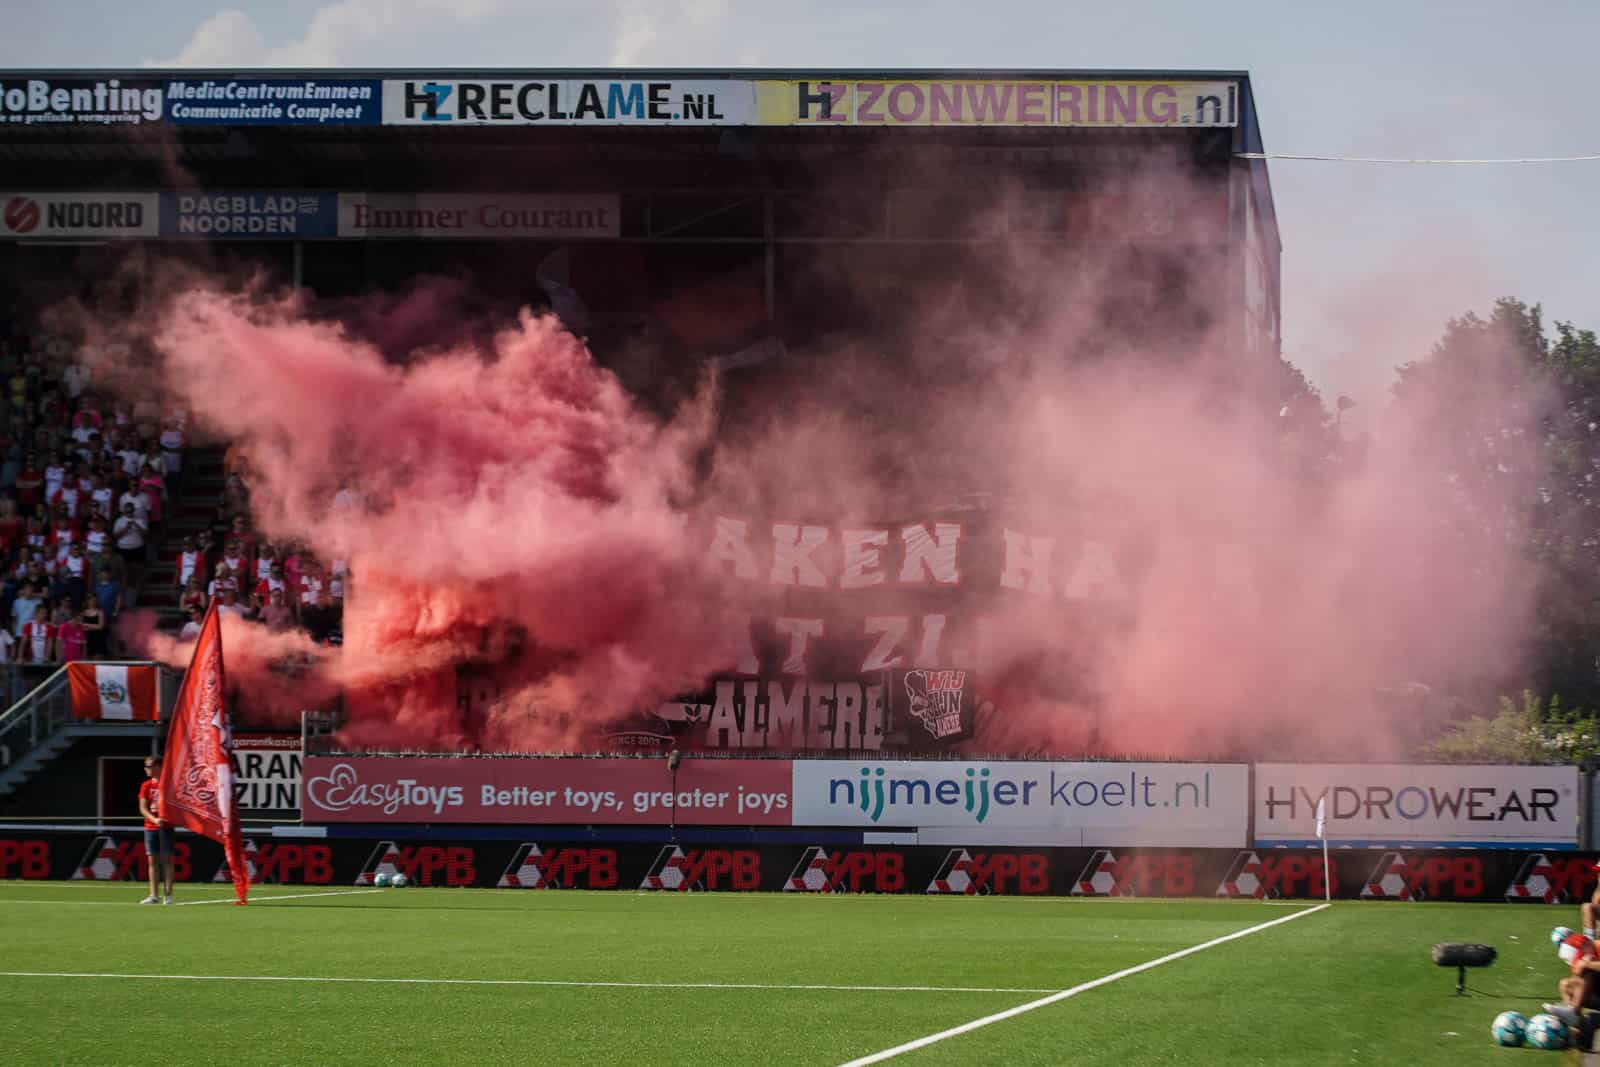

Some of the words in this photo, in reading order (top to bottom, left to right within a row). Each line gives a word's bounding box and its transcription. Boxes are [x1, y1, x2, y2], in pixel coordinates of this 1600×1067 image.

[167, 82, 372, 100] MediaCentrumEmmen
[171, 104, 283, 119] Communicatie
[287, 104, 362, 120] Compleet
[49, 203, 142, 228] NOORD
[179, 197, 297, 213] DAGBLAD
[353, 203, 469, 229] Emmer
[479, 203, 609, 229] Courant
[179, 216, 296, 232] NOORDEN
[481, 783, 557, 808] Better
[564, 785, 624, 812] toys,
[633, 785, 729, 811] greater
[737, 785, 788, 814] joys
[829, 767, 1037, 824] nijmeijer
[1049, 770, 1211, 809] koelt.nl
[1265, 786, 1559, 823] HYDROWEAR
